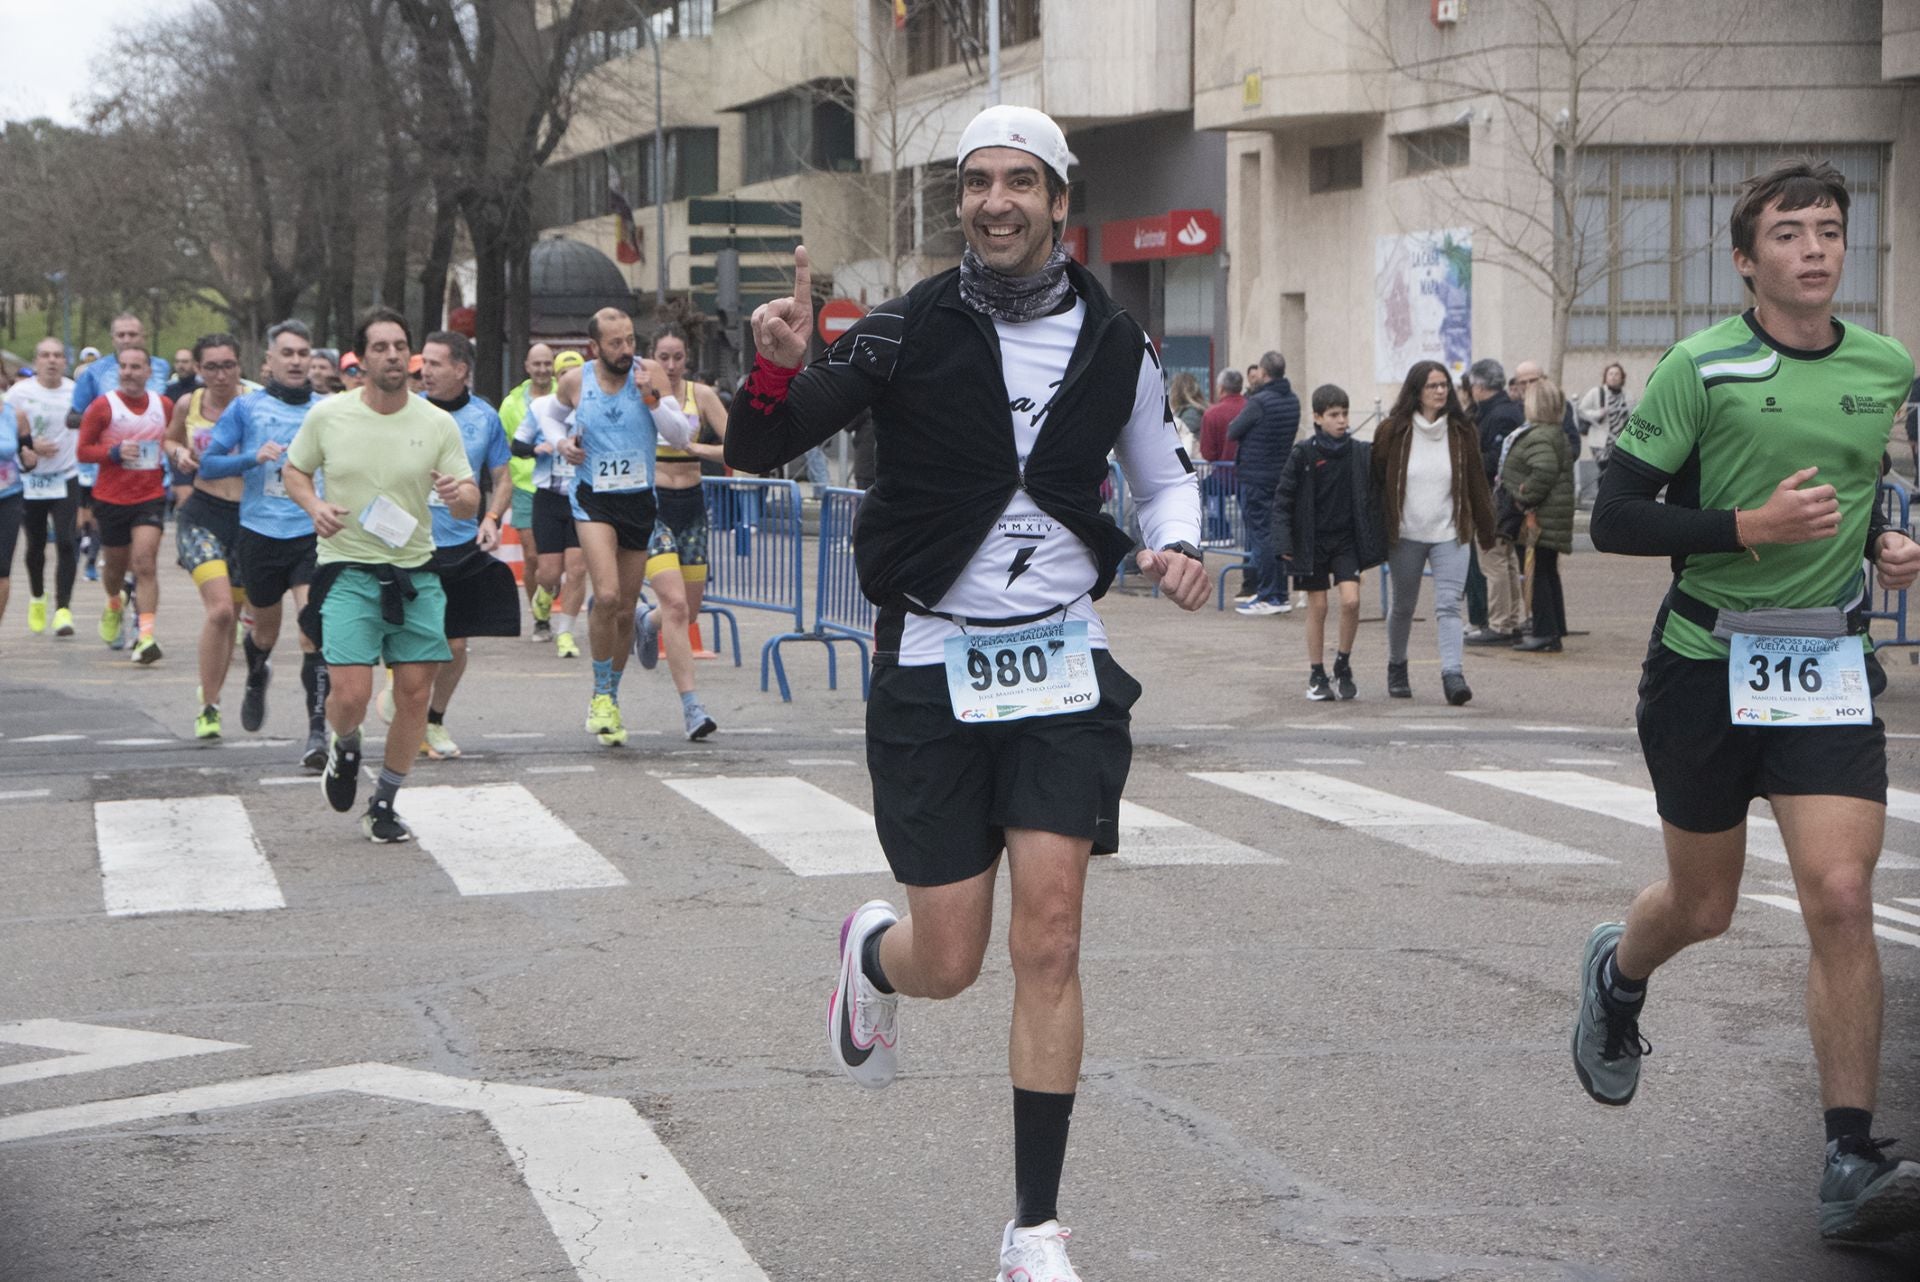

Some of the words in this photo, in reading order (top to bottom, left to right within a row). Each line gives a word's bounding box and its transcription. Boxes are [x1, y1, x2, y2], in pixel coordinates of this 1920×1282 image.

[861, 341, 877, 364] LIFE
[599, 459, 630, 477] 212
[970, 637, 1004, 648] VUELTA
[1020, 627, 1065, 641] BALUARTE
[1772, 637, 1803, 645] CROSS
[1754, 641, 1786, 651] VUELTA
[1788, 644, 1800, 652] AL
[967, 644, 1048, 691] 980
[1748, 655, 1823, 693] 316
[1063, 692, 1093, 705] HOY
[1751, 694, 1778, 702] MANUEL
[1835, 707, 1865, 717] HOY
